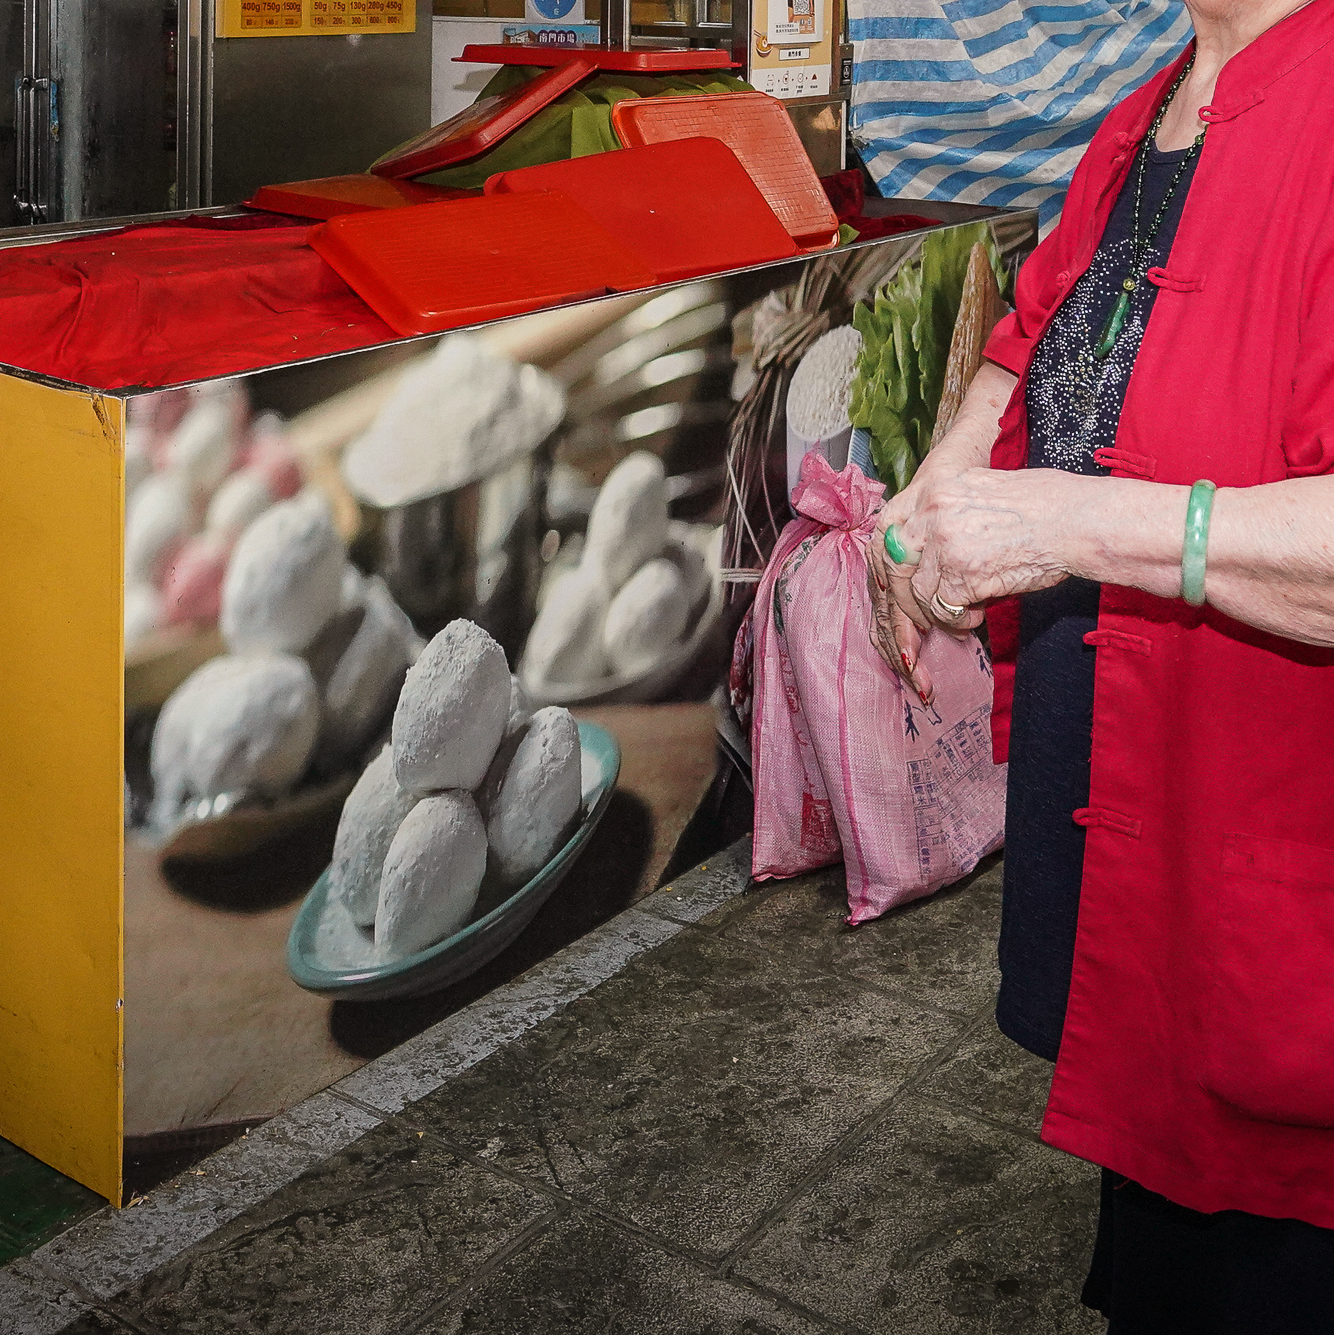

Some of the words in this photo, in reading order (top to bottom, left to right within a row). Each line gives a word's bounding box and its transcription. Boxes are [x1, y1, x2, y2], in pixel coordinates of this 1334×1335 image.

[314, 1, 327, 12] 50g
[332, 1, 345, 12] 75g
[350, 1, 366, 12] 130g
[539, 32, 575, 44] 南門市場
